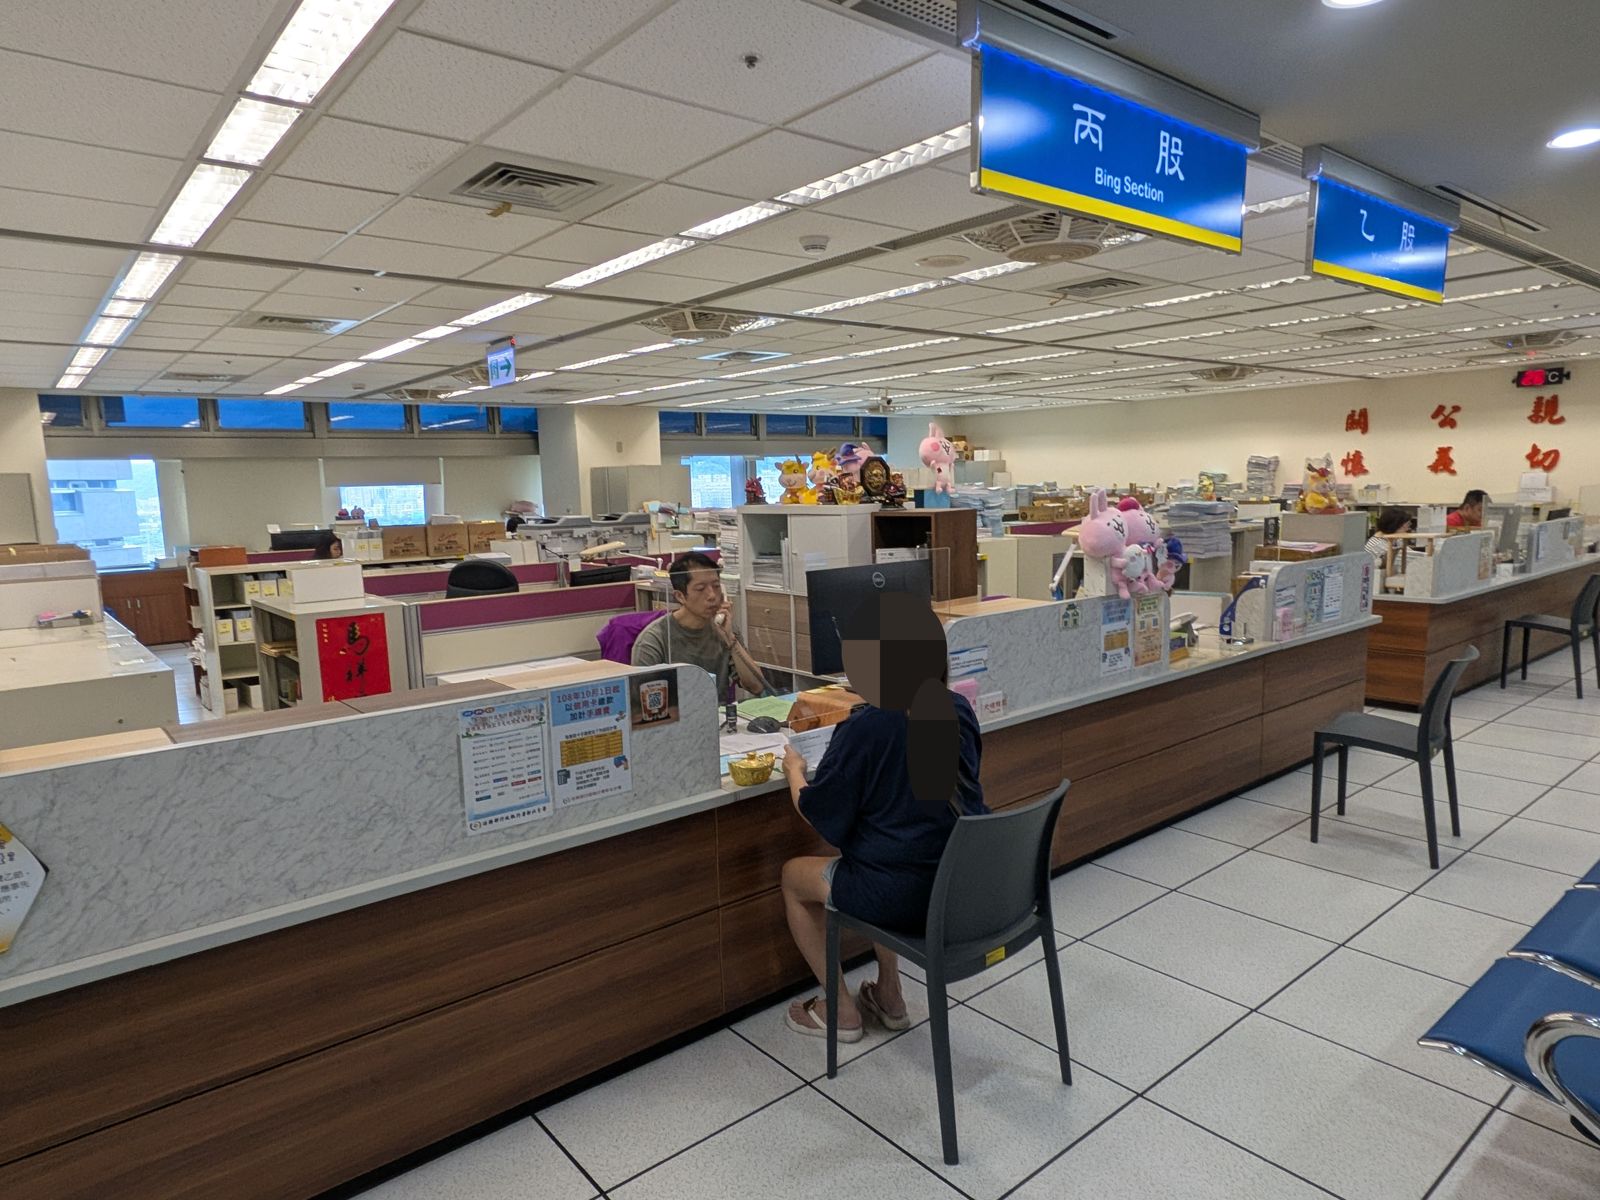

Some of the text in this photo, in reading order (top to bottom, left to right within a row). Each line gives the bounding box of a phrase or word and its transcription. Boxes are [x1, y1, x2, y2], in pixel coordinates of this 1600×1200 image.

[1072, 103, 1185, 181] 丙股
[1094, 166, 1164, 203] Bing Section
